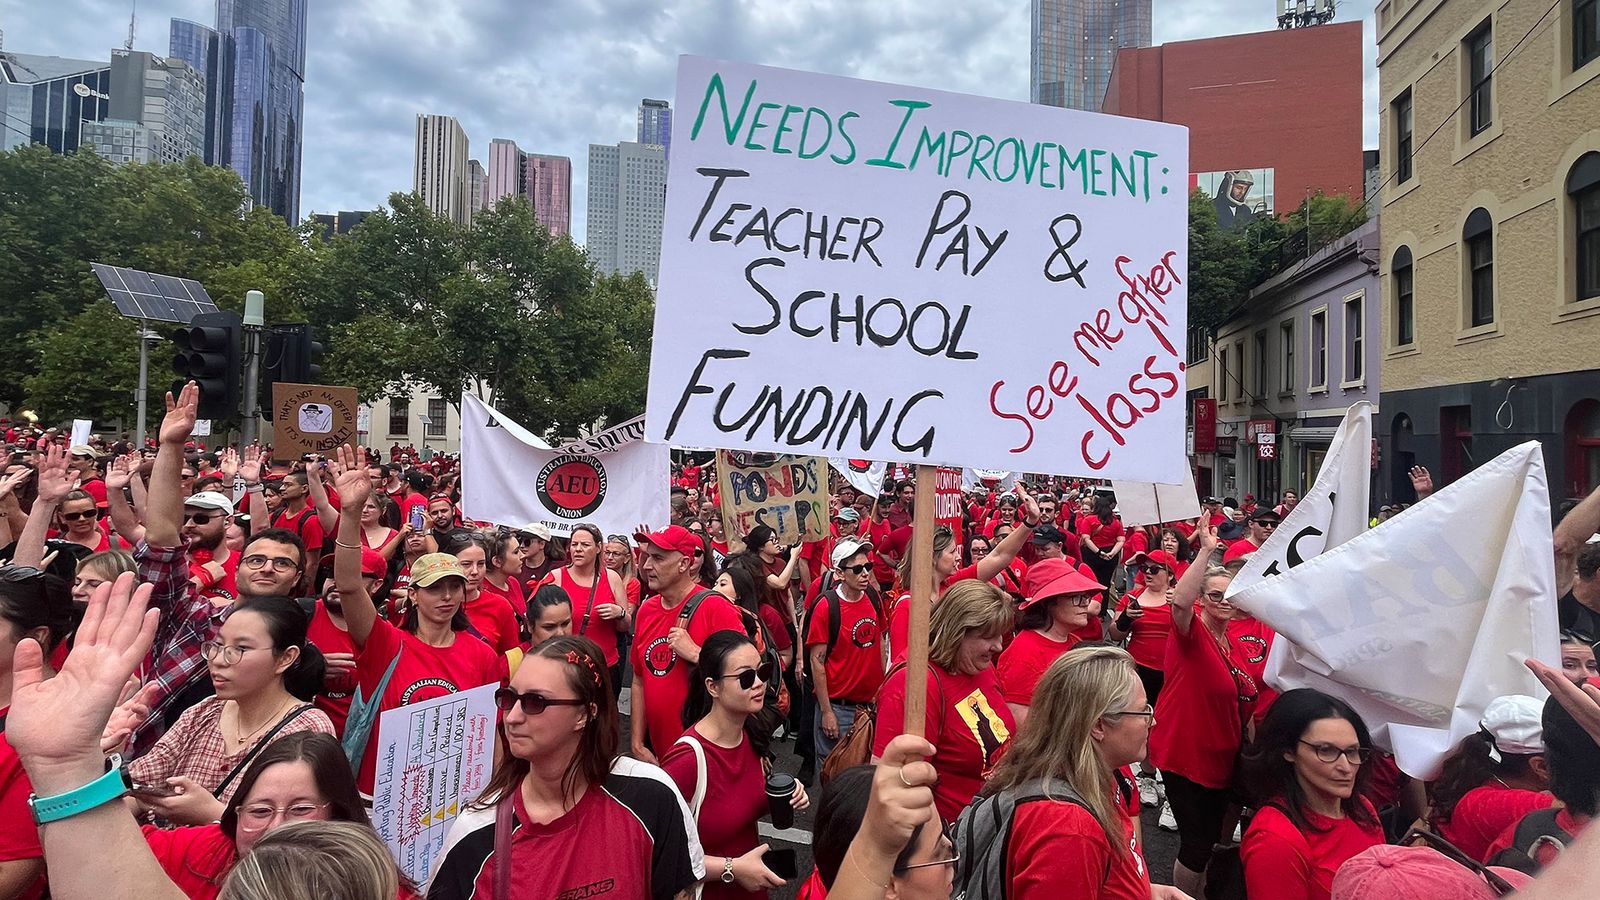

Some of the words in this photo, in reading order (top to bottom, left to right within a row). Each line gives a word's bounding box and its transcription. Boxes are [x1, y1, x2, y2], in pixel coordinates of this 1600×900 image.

[691, 73, 859, 164] NEEDS
[865, 100, 1169, 202] IMPROVEMENT:
[689, 168, 884, 267] TEACHER
[915, 190, 1009, 276] PAY
[1044, 213, 1088, 289] &
[732, 257, 978, 360] SCHOOL
[990, 360, 1078, 453] See
[1073, 308, 1124, 367] me
[1114, 250, 1182, 326] after
[296, 389, 314, 401] NOT
[321, 391, 335, 401] AN
[334, 399, 353, 424] OFFER!
[664, 349, 944, 458] FUNDING
[1081, 318, 1186, 470] class!
[299, 438, 313, 448] AN
[537, 455, 579, 493] AUSTRALIAN
[581, 455, 607, 497] EDUCATION
[548, 474, 598, 495] AEU
[730, 458, 818, 505] PONDS
[556, 506, 582, 518] UNION
[935, 492, 962, 519] TUDENTS
[557, 521, 575, 531] BRA
[402, 679, 438, 706] AUSTRALIAN
[437, 679, 459, 694] EDUCA
[457, 706, 466, 721] SRS
[412, 712, 425, 751] Standard
[440, 714, 453, 750] Reduced
[465, 735, 474, 766] resubmit
[461, 768, 471, 795] Please
[375, 785, 392, 812] Public
[376, 810, 394, 842] pporting
[402, 843, 414, 878] riteria
[557, 879, 614, 900] ERANS
